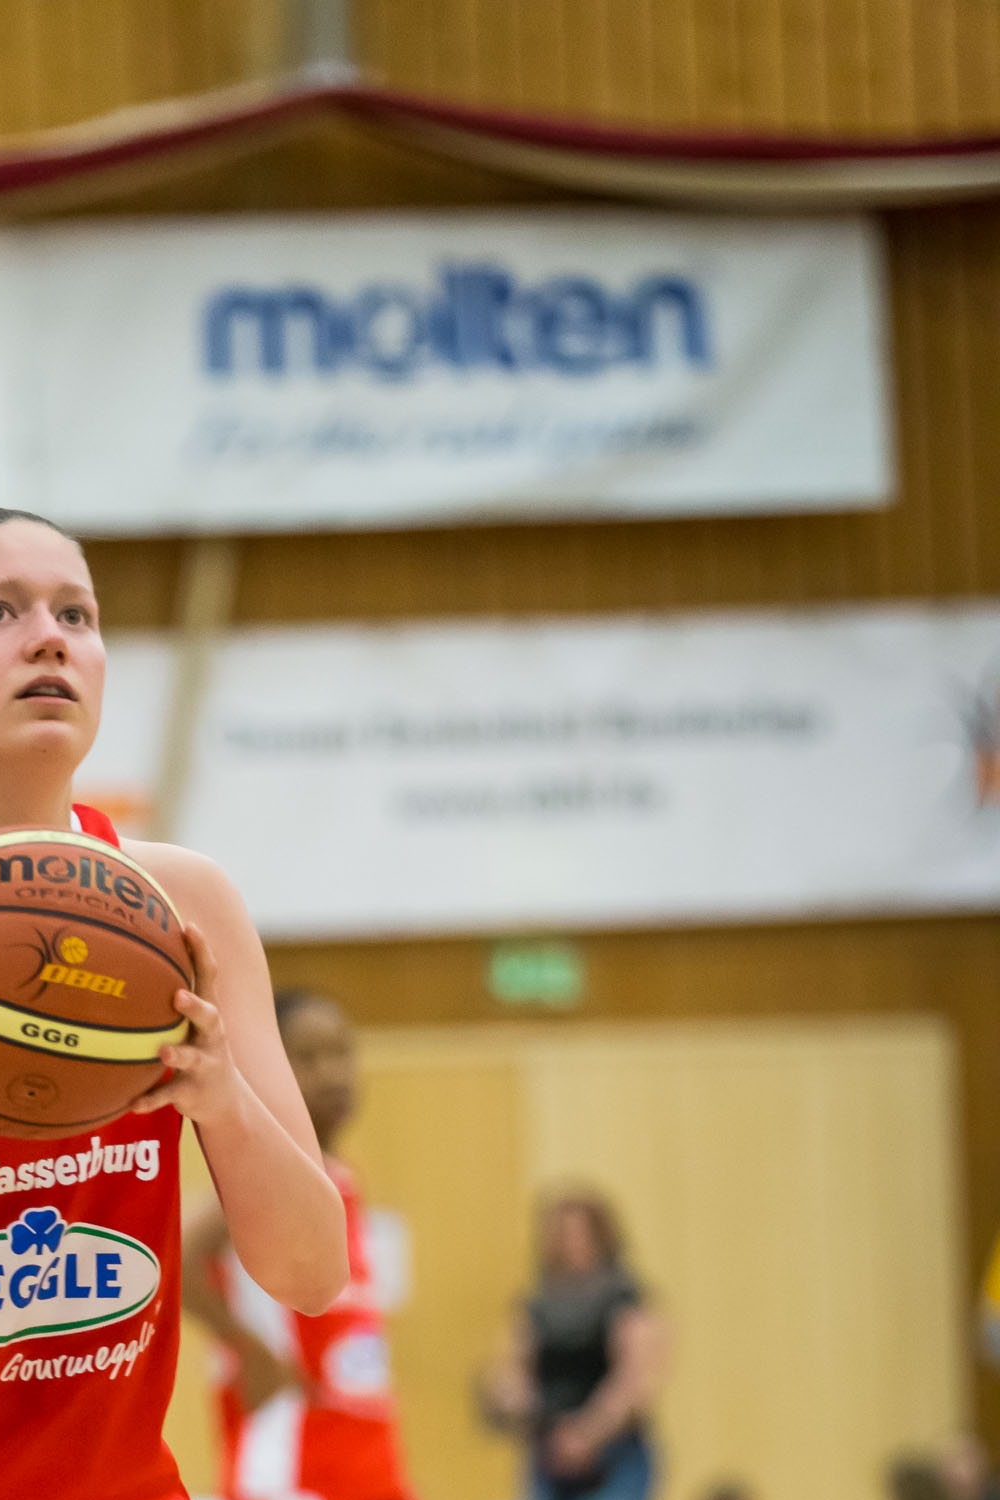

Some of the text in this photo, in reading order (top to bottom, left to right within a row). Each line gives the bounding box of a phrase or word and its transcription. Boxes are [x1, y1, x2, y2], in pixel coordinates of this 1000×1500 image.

[202, 262, 712, 380] molten
[15, 888, 138, 926] OFFICIAL
[40, 964, 127, 999] DBBL
[20, 1022, 81, 1048] GG6
